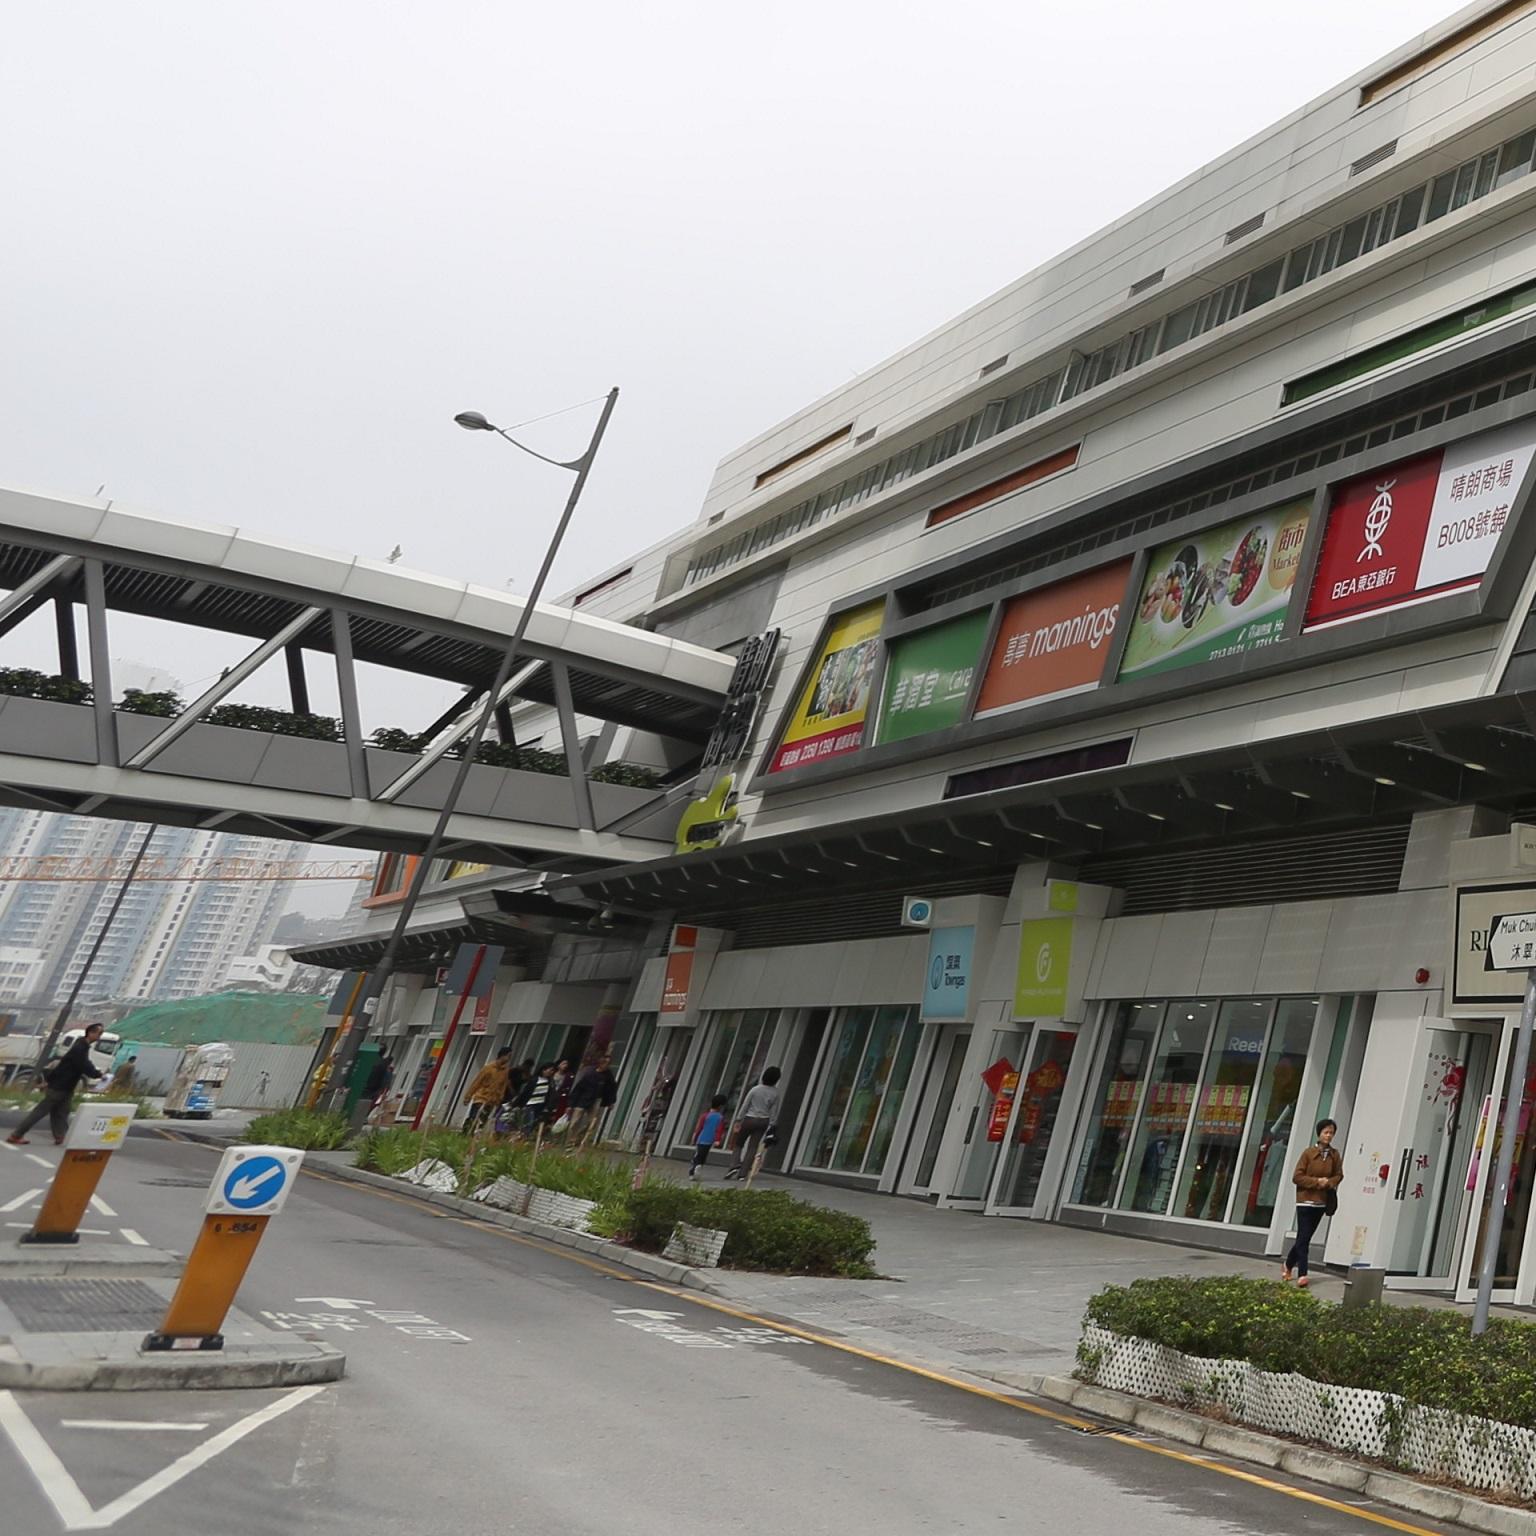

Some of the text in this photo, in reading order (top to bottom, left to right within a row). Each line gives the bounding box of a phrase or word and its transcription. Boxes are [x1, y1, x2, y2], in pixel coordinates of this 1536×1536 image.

[1450, 459, 1513, 504] 晴朗商場
[1437, 503, 1509, 549] B008號舖
[1028, 602, 1120, 659] mannings
[1500, 920, 1516, 934] Muk
